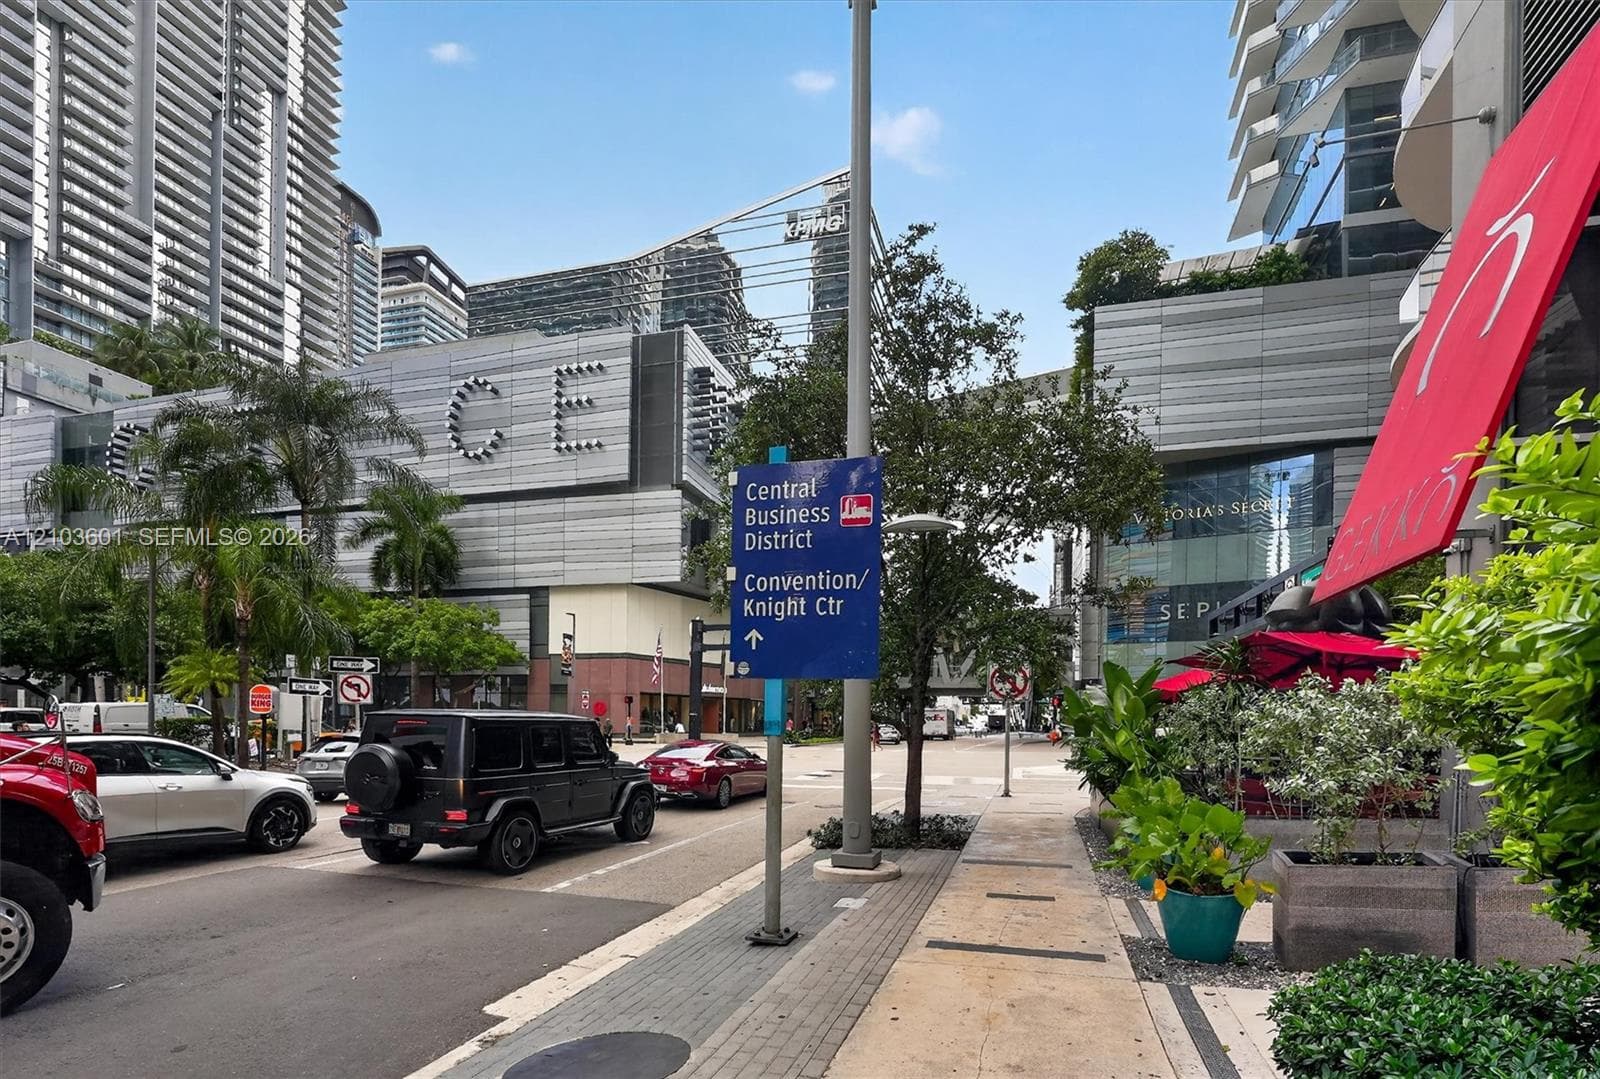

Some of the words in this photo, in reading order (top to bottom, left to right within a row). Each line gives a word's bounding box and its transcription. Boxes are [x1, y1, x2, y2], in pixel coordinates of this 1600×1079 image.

[784, 211, 843, 239] KPMG
[746, 478, 817, 501] Central
[745, 505, 830, 526] Business
[745, 529, 813, 550] District
[744, 569, 869, 592] Convention/
[743, 597, 806, 621] Knight
[815, 597, 844, 616] Ctr
